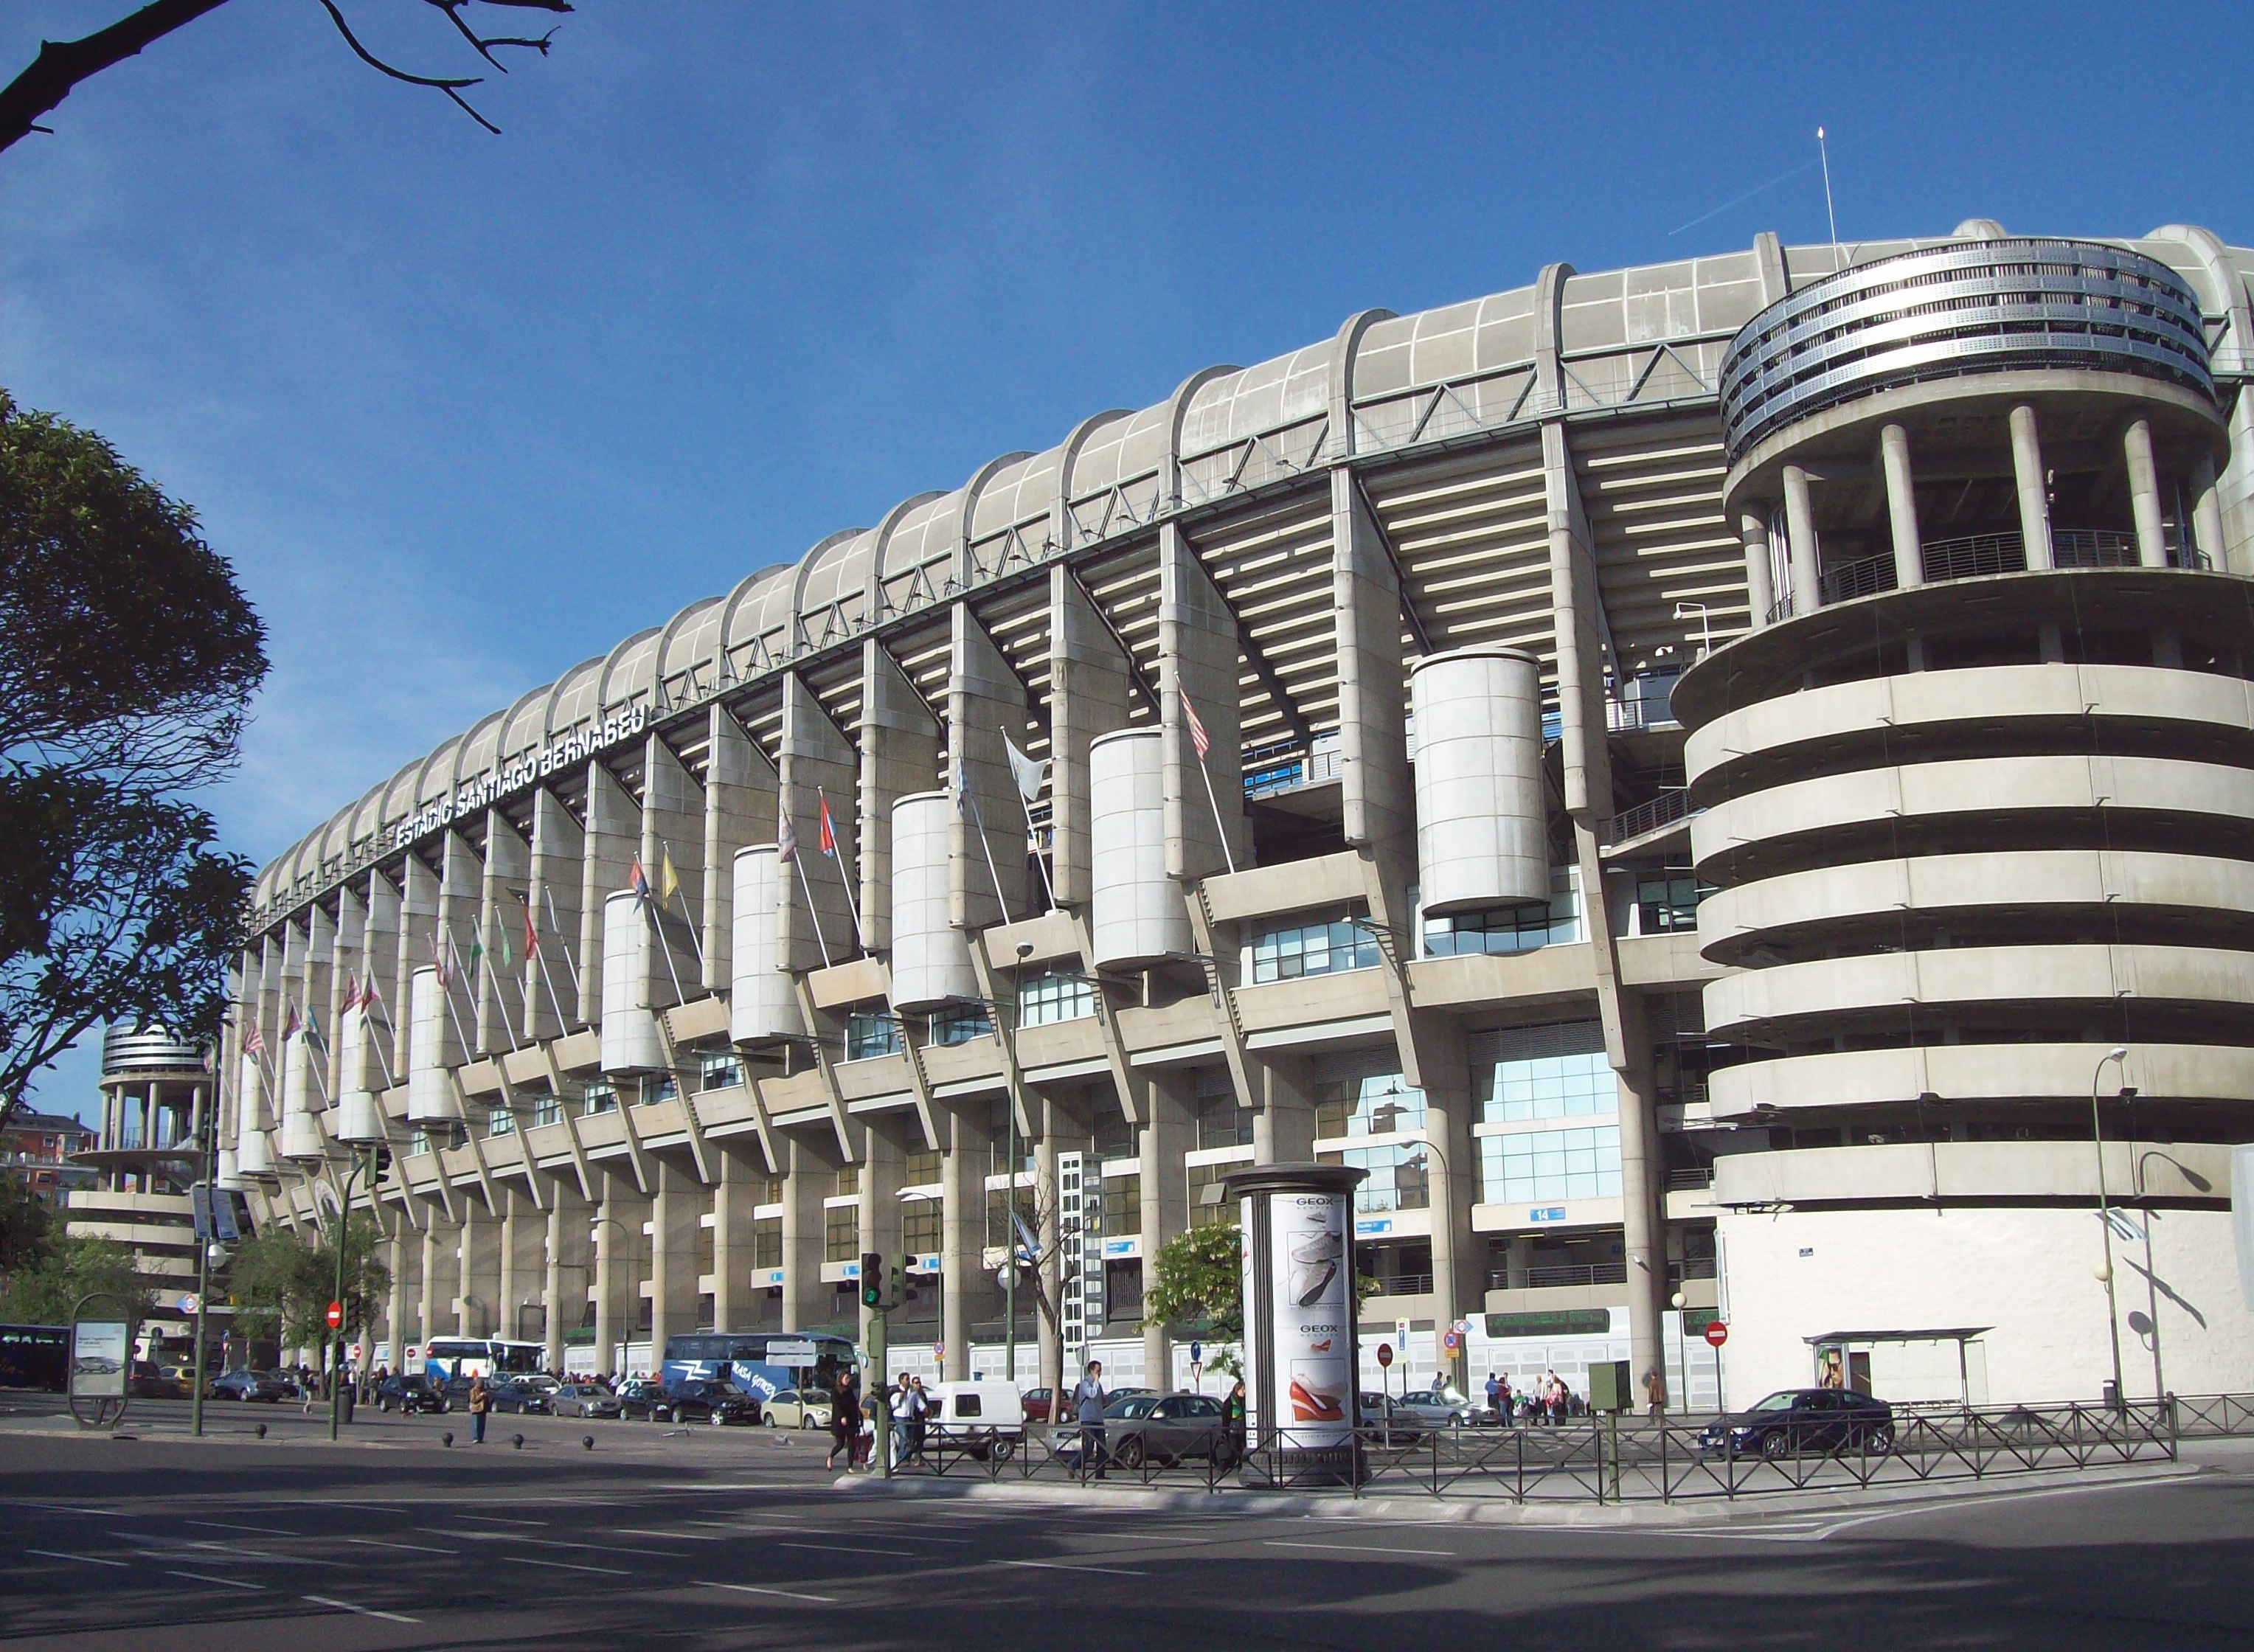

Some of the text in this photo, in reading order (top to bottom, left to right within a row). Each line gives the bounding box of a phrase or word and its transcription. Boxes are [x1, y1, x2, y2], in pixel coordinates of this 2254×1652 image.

[396, 704, 645, 849] ESTADIO SANTIAGO BERNABEU
[1295, 1197, 1334, 1206] GEOX
[1536, 1210, 1549, 1221] 14
[1300, 1325, 1339, 1333] GEOX
